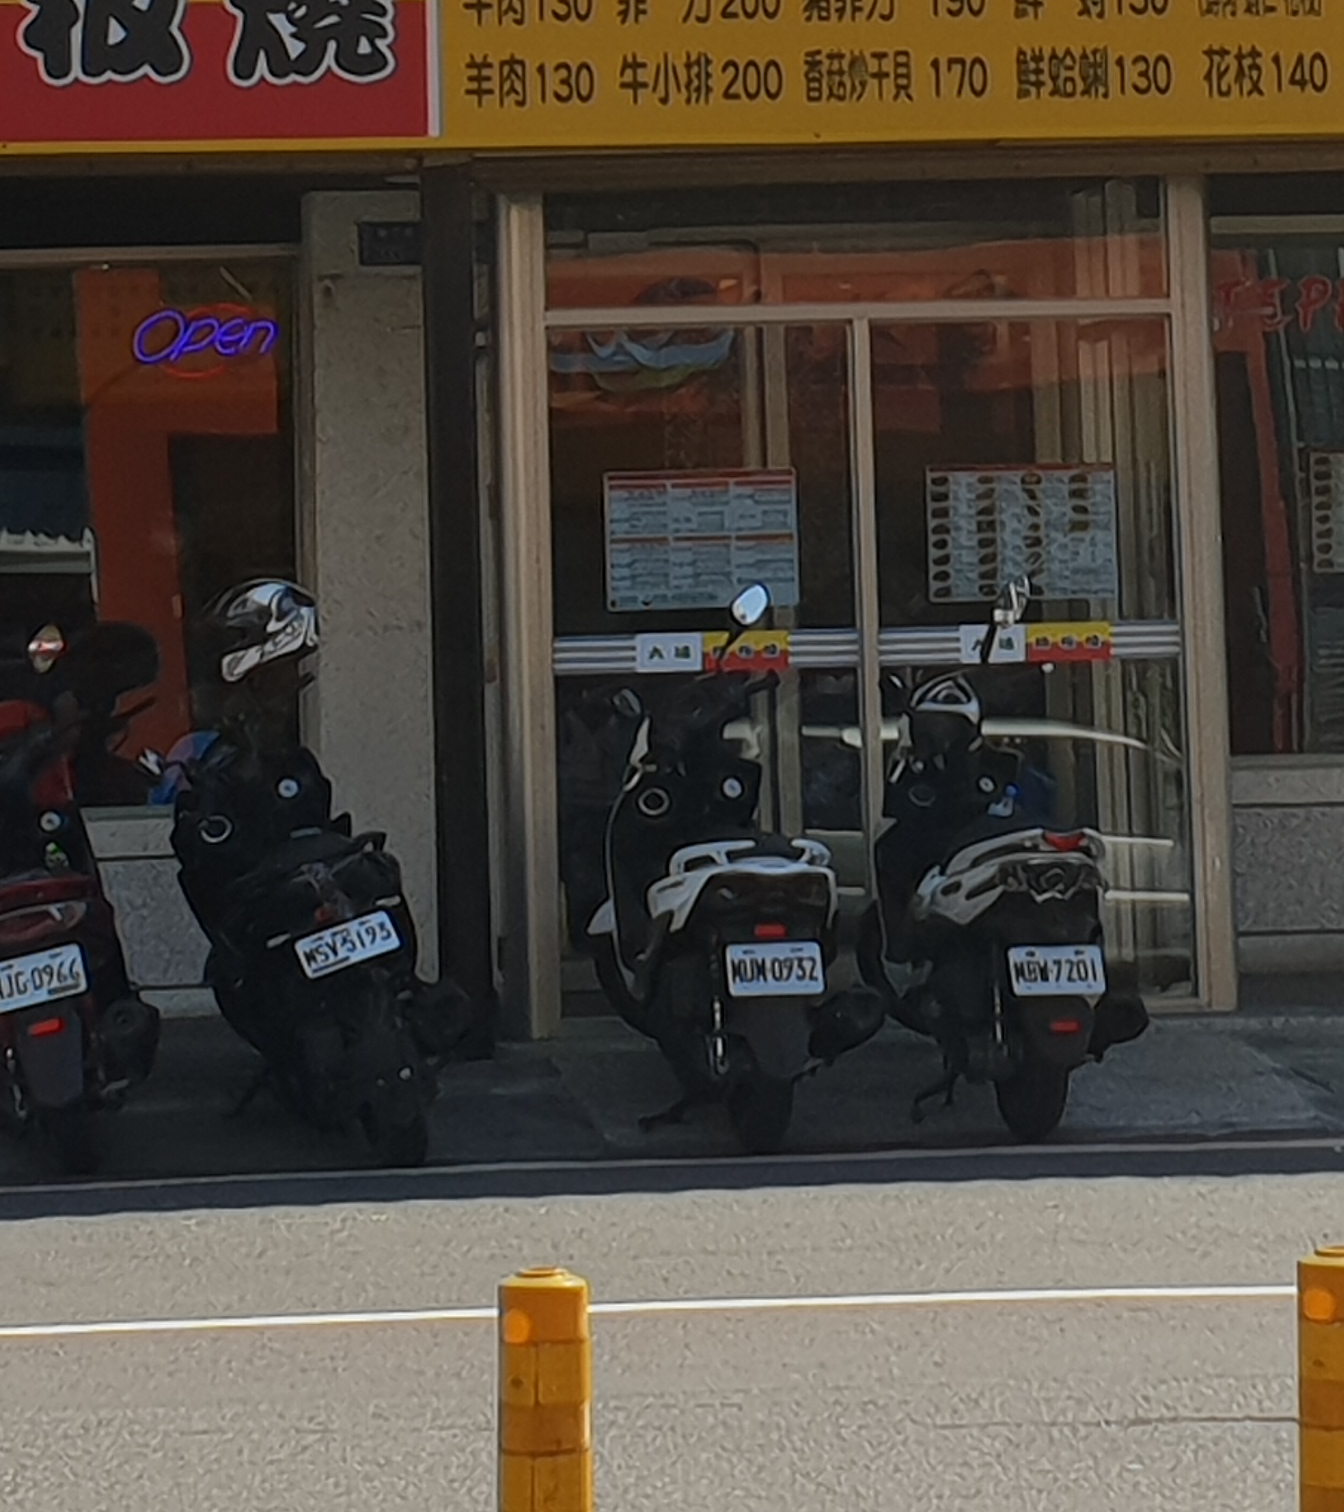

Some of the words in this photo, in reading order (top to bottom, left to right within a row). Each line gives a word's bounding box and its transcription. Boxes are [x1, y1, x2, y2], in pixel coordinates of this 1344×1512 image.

[464, 52, 527, 109] 羊肉
[535, 61, 595, 104] 130
[618, 50, 714, 106] 牛小排
[720, 58, 783, 102] 200
[929, 56, 988, 99] 170
[1015, 45, 1110, 100] 鮮蛤蜊
[1114, 53, 1172, 96] 130
[1201, 44, 1265, 99] 花枝
[1271, 51, 1328, 94] 140
[132, 308, 280, 364] Open
